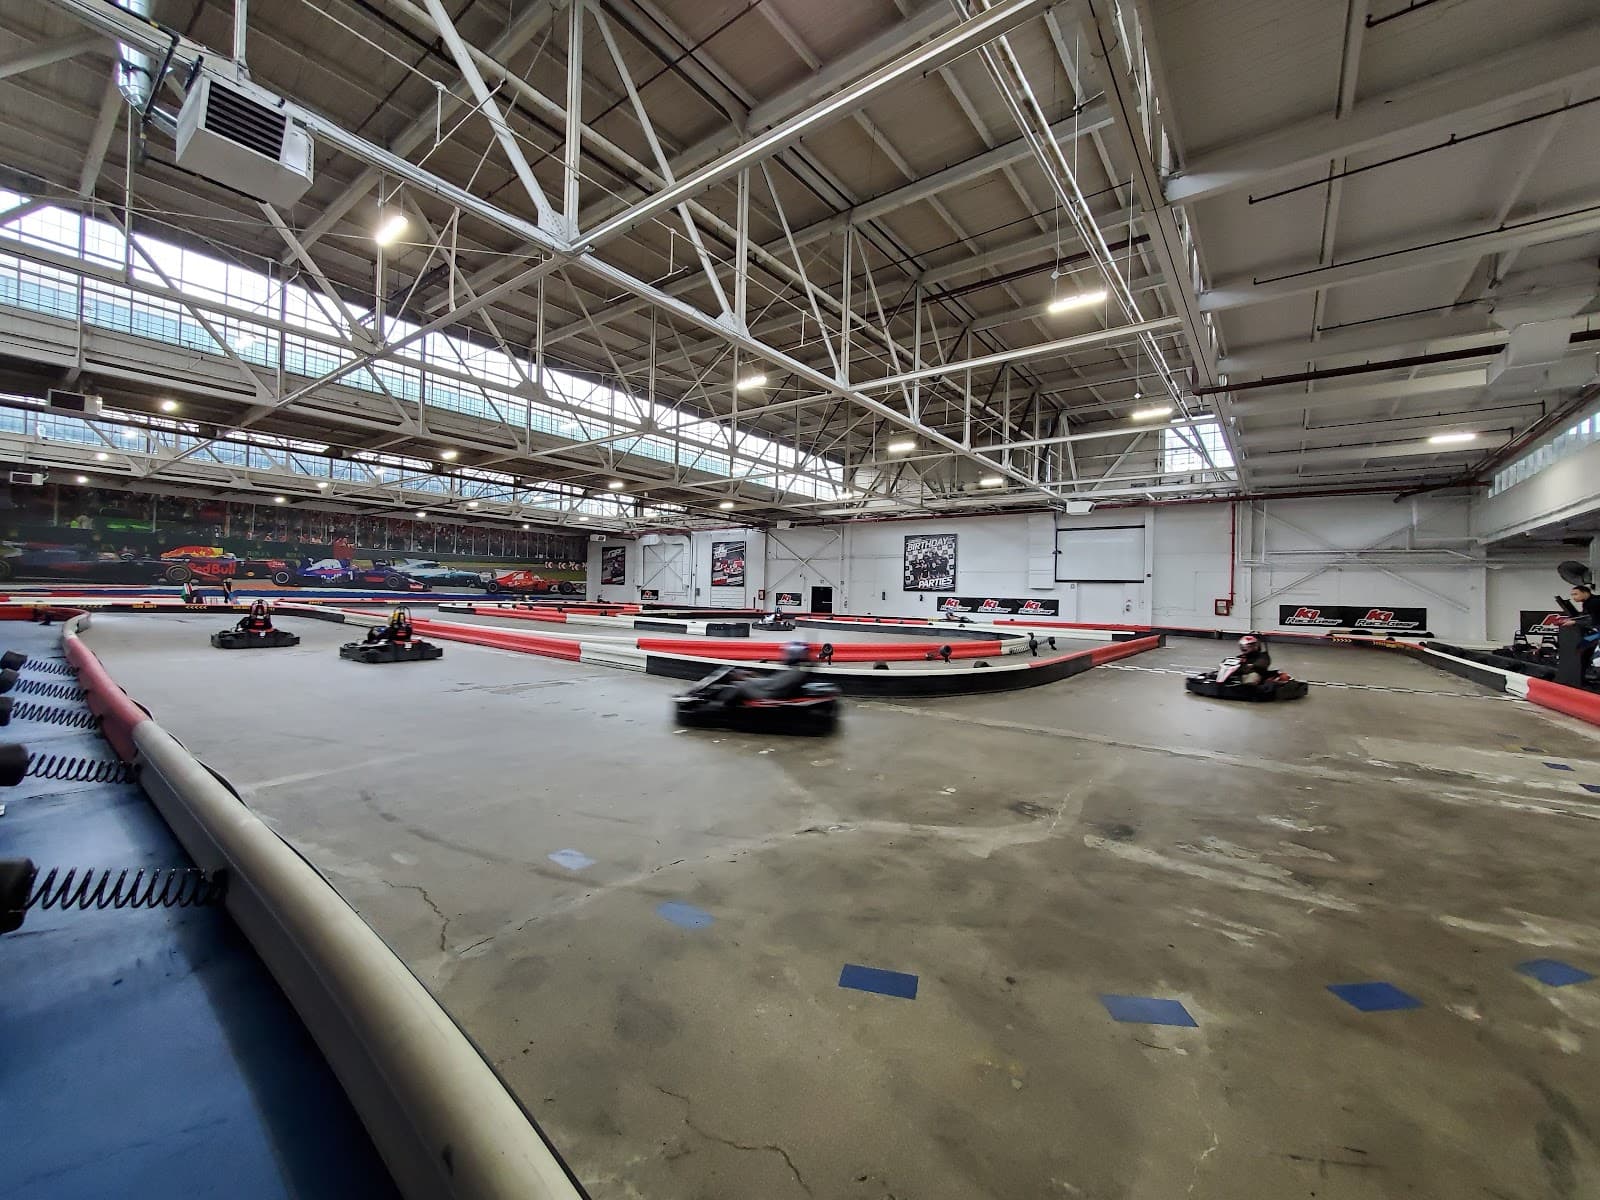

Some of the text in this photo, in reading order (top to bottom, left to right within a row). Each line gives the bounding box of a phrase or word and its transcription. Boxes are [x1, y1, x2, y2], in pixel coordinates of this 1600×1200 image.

[906, 537, 949, 551] BIRTHDAY
[918, 577, 953, 589] PARTIES
[1023, 600, 1041, 610] K1
[1294, 607, 1321, 620] K1
[1364, 609, 1394, 622] K1
